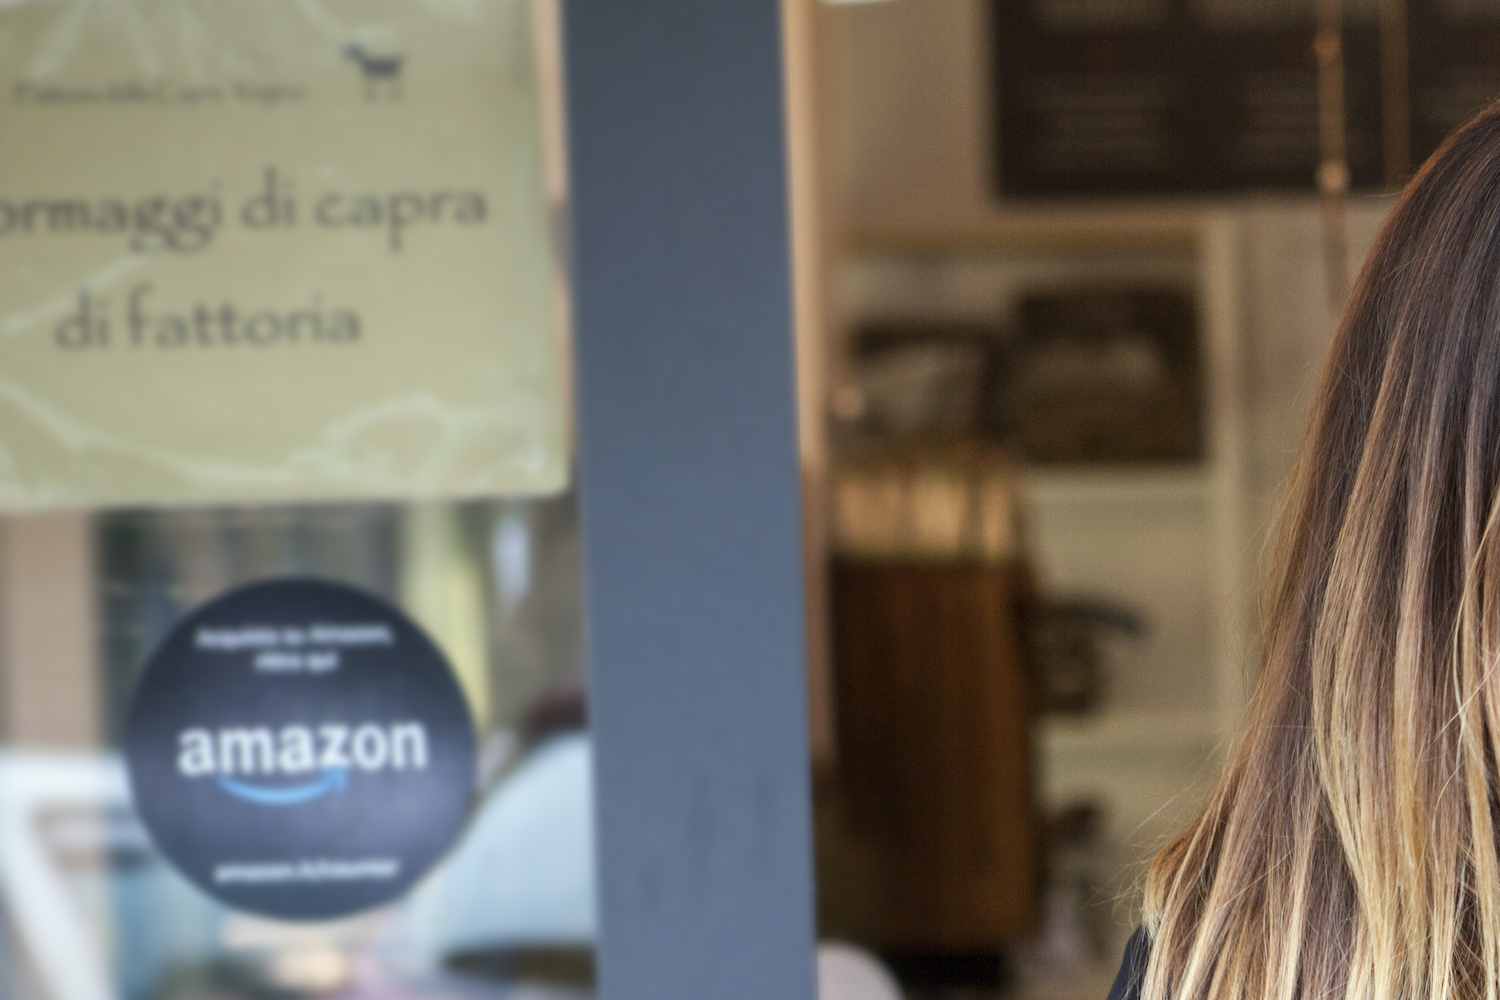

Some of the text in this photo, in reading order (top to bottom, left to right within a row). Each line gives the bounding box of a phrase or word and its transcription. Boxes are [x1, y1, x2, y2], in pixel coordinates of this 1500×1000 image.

[241, 165, 296, 231] di
[314, 190, 489, 253] capra
[54, 283, 362, 349] di fattoria
[177, 720, 429, 776] amazon
